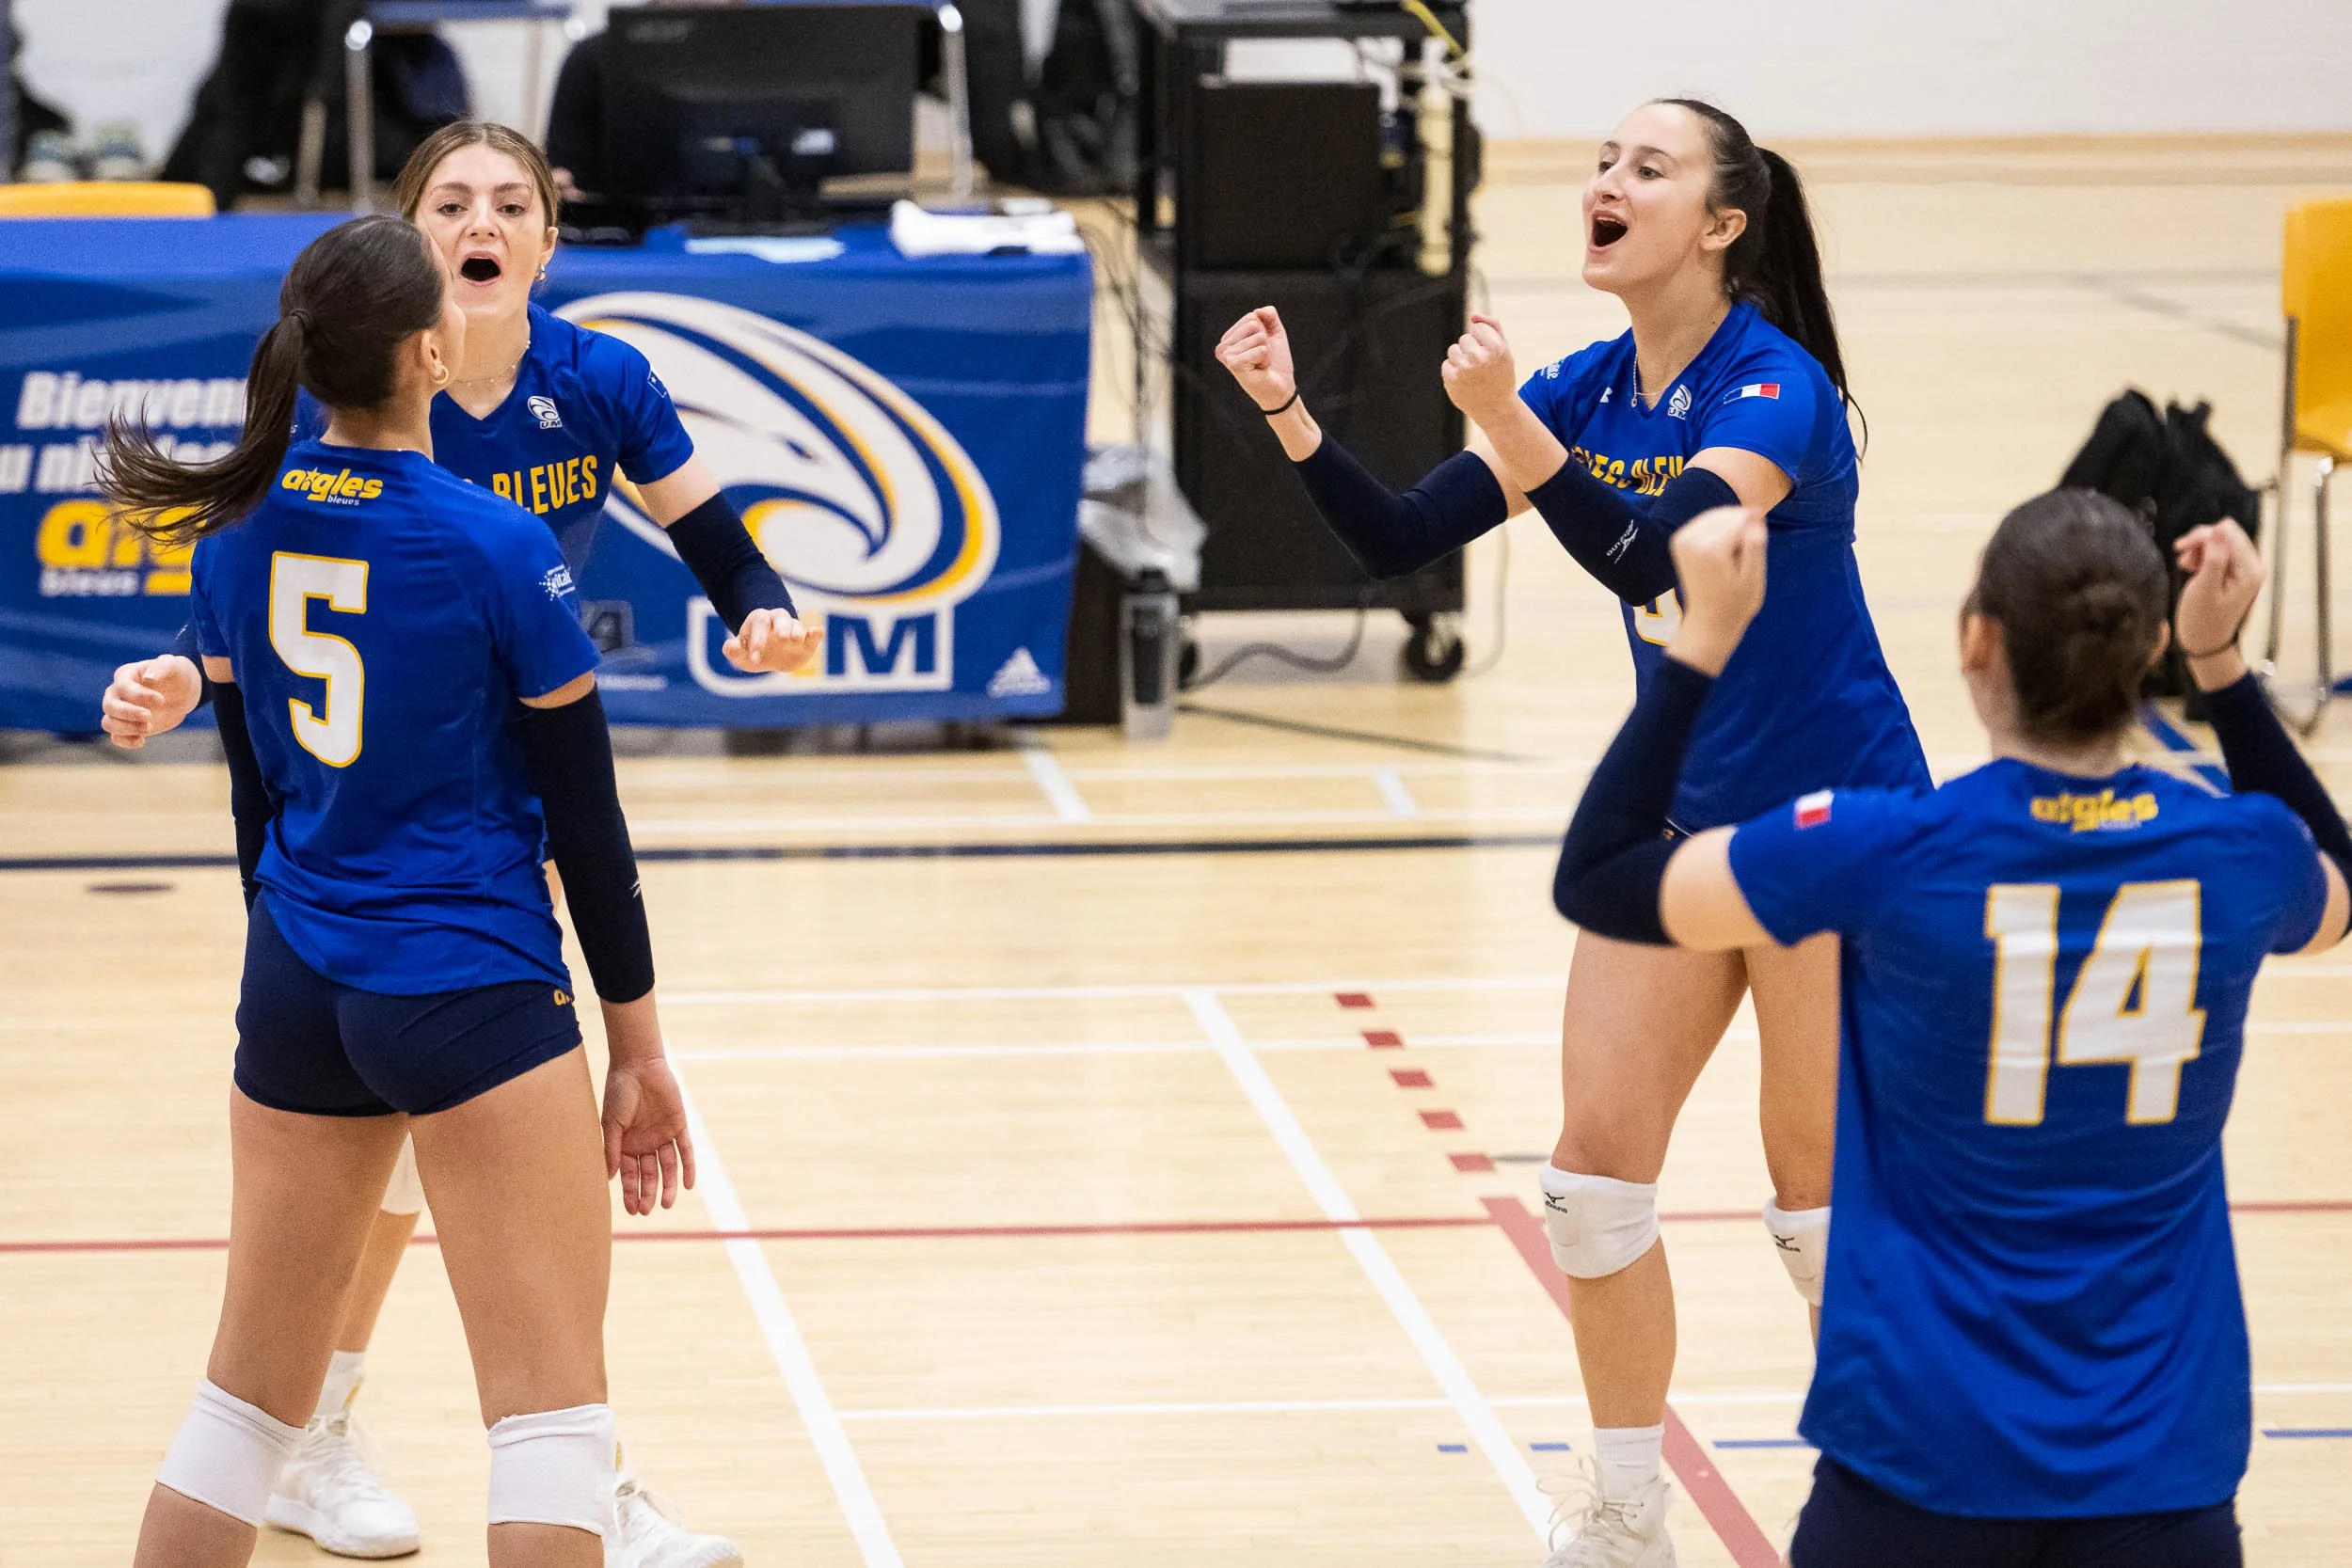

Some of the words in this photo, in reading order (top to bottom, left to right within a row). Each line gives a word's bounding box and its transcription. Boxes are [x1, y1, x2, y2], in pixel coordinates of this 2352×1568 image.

[0, 444, 33, 493] u
[281, 467, 384, 502] aigles
[492, 454, 598, 515] BLEUES
[326, 494, 359, 506] bleues
[268, 550, 370, 768] 5
[1983, 879, 2208, 1127] 14
